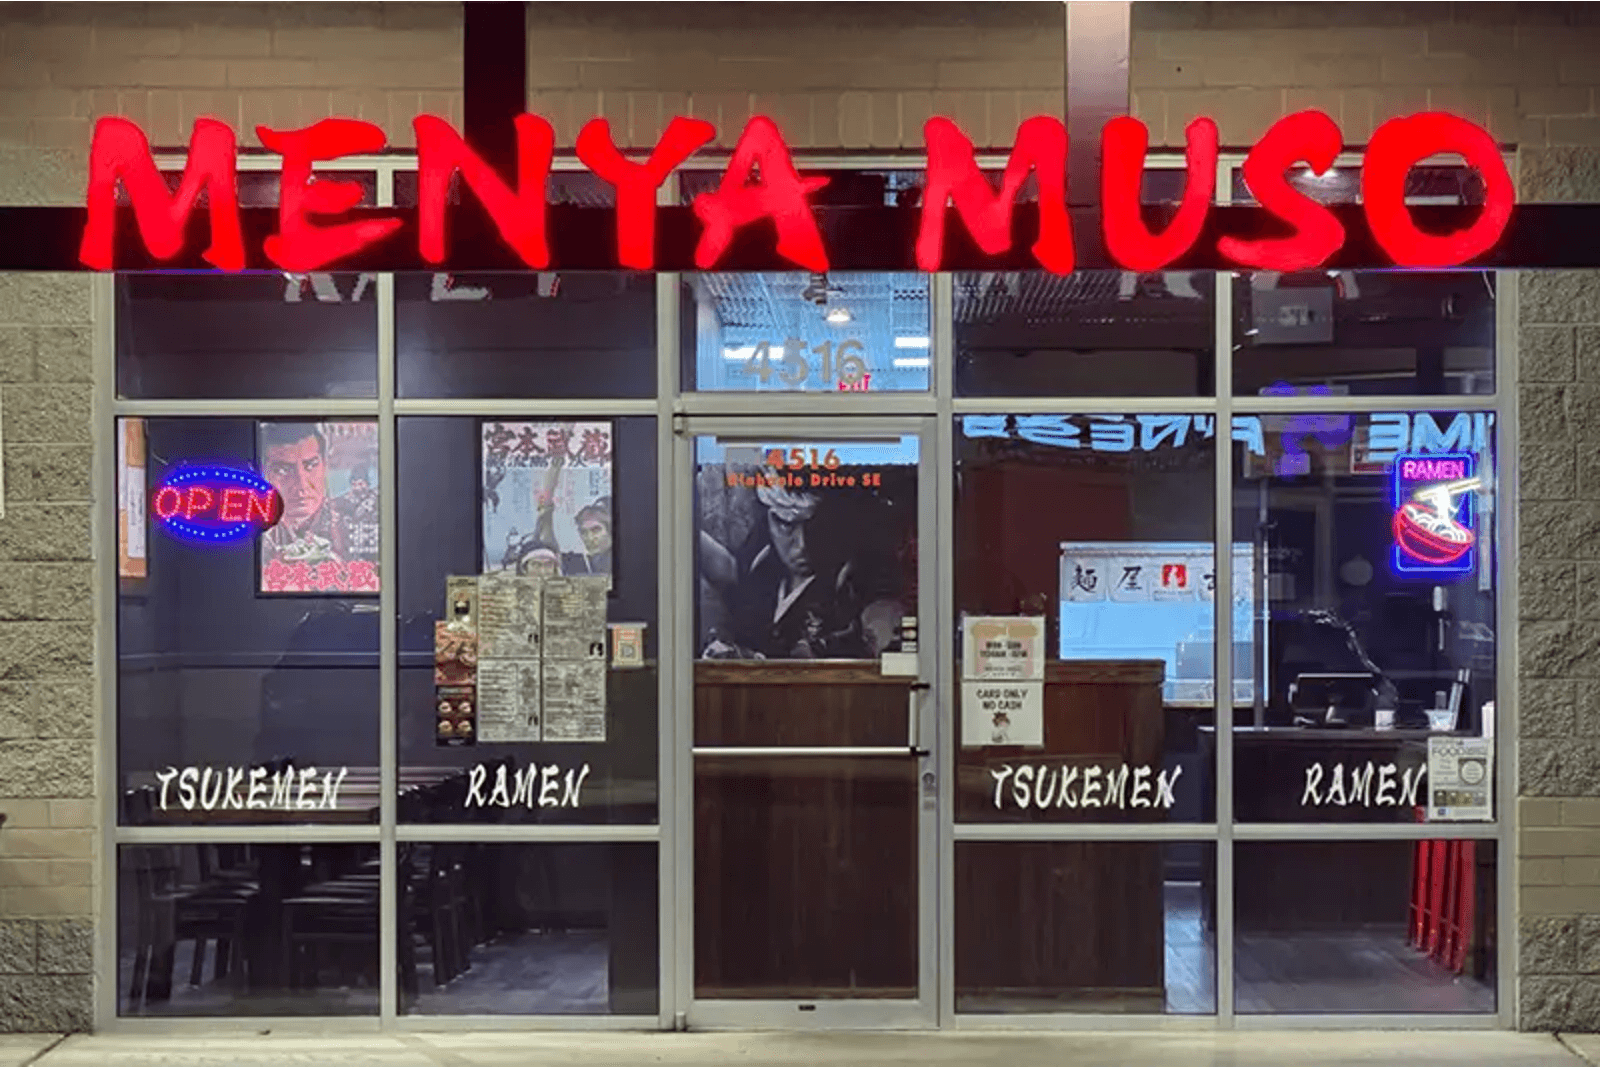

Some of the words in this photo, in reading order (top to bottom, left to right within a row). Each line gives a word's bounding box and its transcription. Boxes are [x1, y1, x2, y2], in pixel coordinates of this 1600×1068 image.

[80, 113, 829, 273] MENYA
[916, 109, 1513, 276] MUSO
[743, 339, 865, 385] 4516
[766, 448, 840, 470] 4516
[810, 472, 856, 486] Drive
[862, 473, 881, 486] SE
[1402, 460, 1465, 479] RAMEN
[154, 485, 276, 522] OPEN
[976, 688, 1001, 699] CARD
[1003, 688, 1029, 699] ONLY
[982, 700, 996, 710] NO
[998, 700, 1023, 710] CASH
[157, 766, 350, 809] TSUKEMEN
[466, 763, 588, 807] RAMEN
[992, 765, 1181, 808] TSUKEMEN
[1302, 762, 1426, 806] RAMEN
